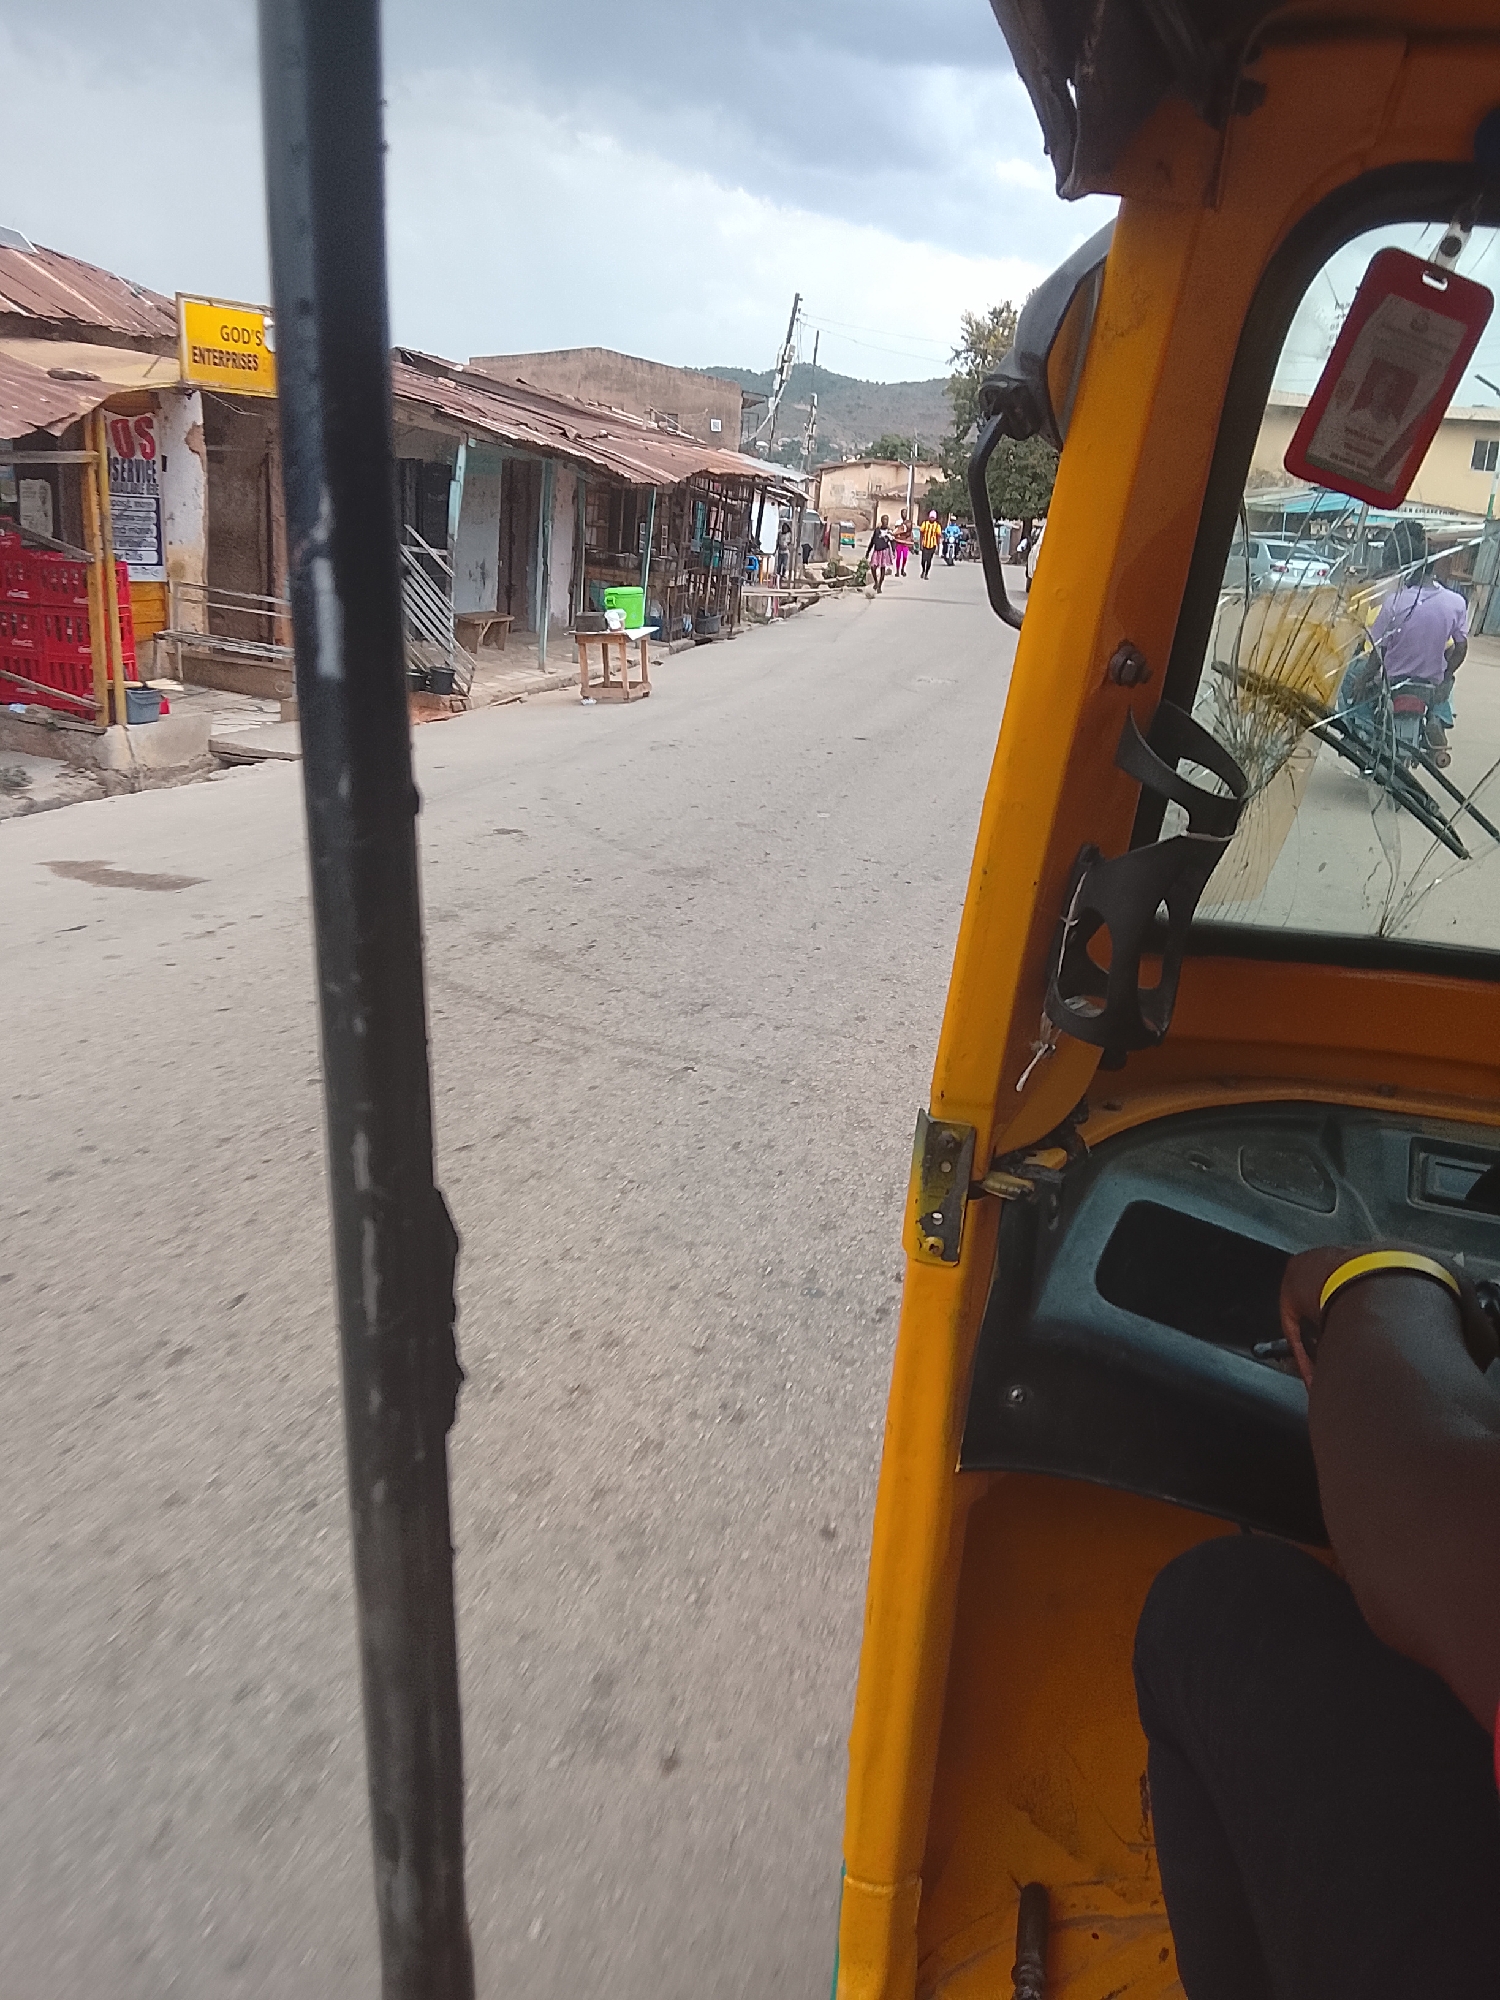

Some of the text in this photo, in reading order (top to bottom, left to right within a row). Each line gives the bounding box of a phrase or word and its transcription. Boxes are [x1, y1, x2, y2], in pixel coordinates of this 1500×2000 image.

[220, 325, 263, 347] GOD'S
[191, 345, 260, 371] ENTERPRISES
[111, 456, 157, 483] SERVICE
